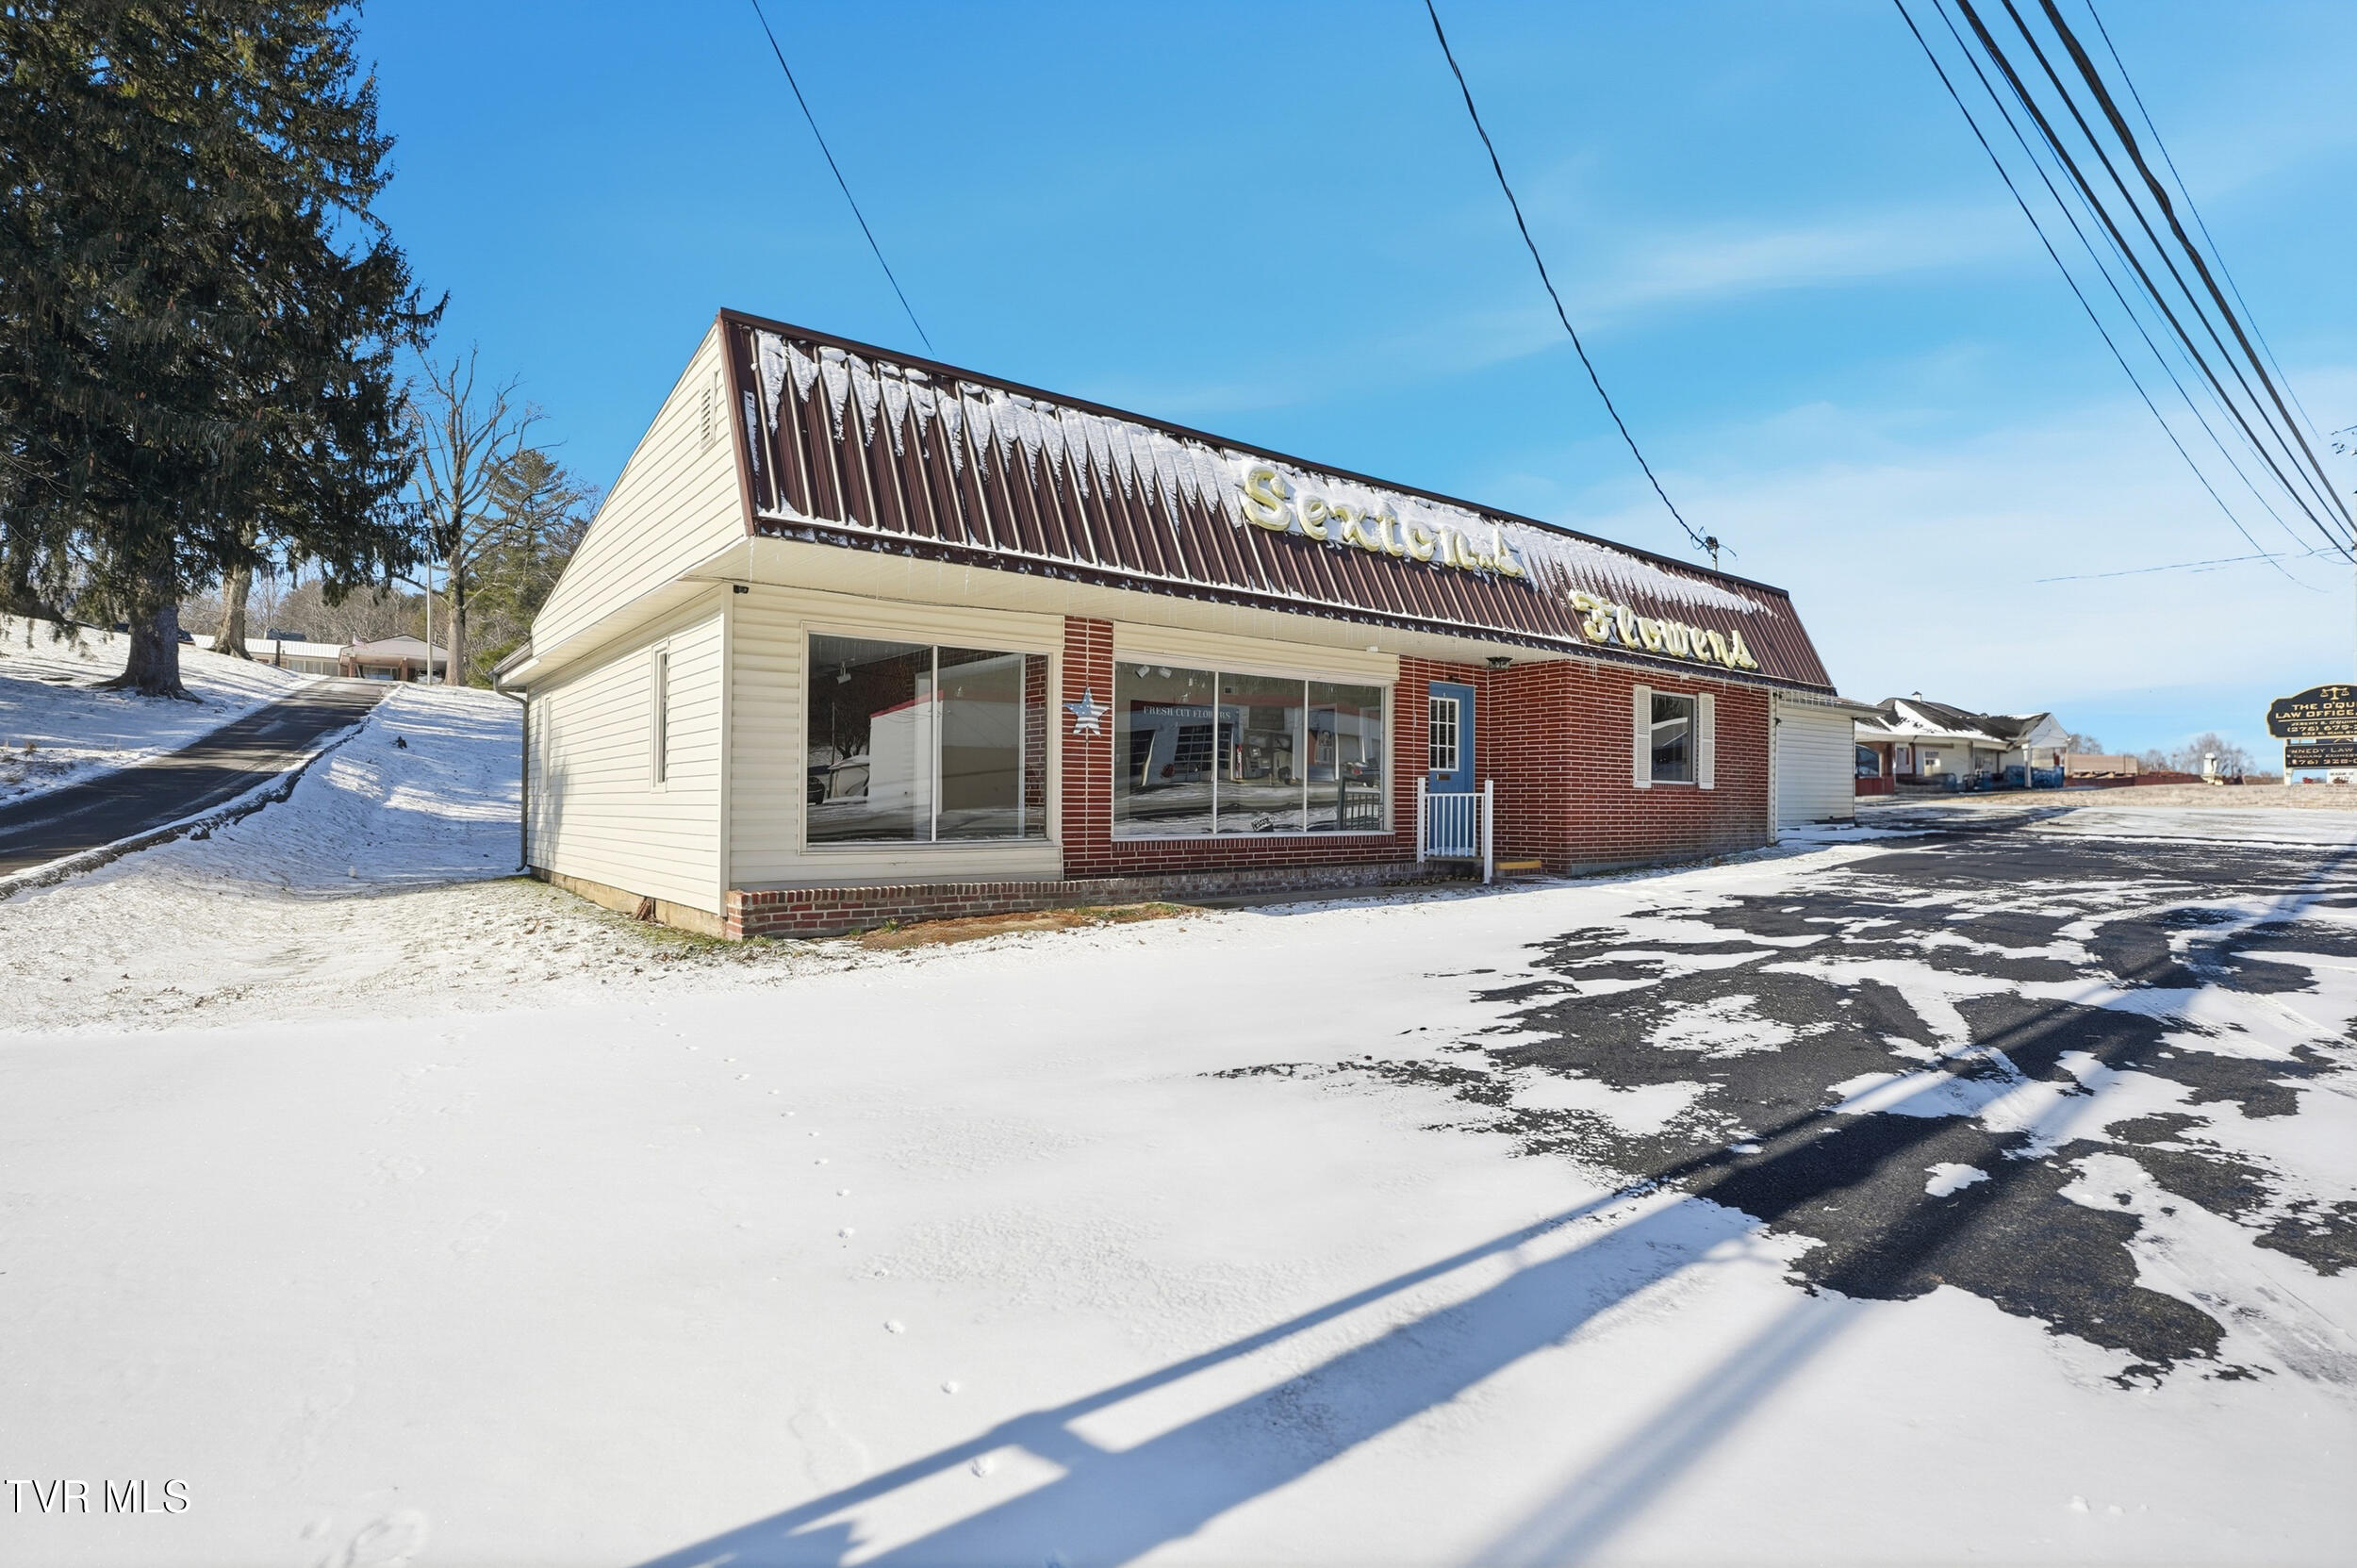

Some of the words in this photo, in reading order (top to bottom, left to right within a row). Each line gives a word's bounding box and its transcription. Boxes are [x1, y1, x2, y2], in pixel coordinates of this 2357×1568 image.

[1569, 588, 1759, 669] Flowers
[1143, 705, 1173, 717] FRESH
[1175, 707, 1190, 718] CUT
